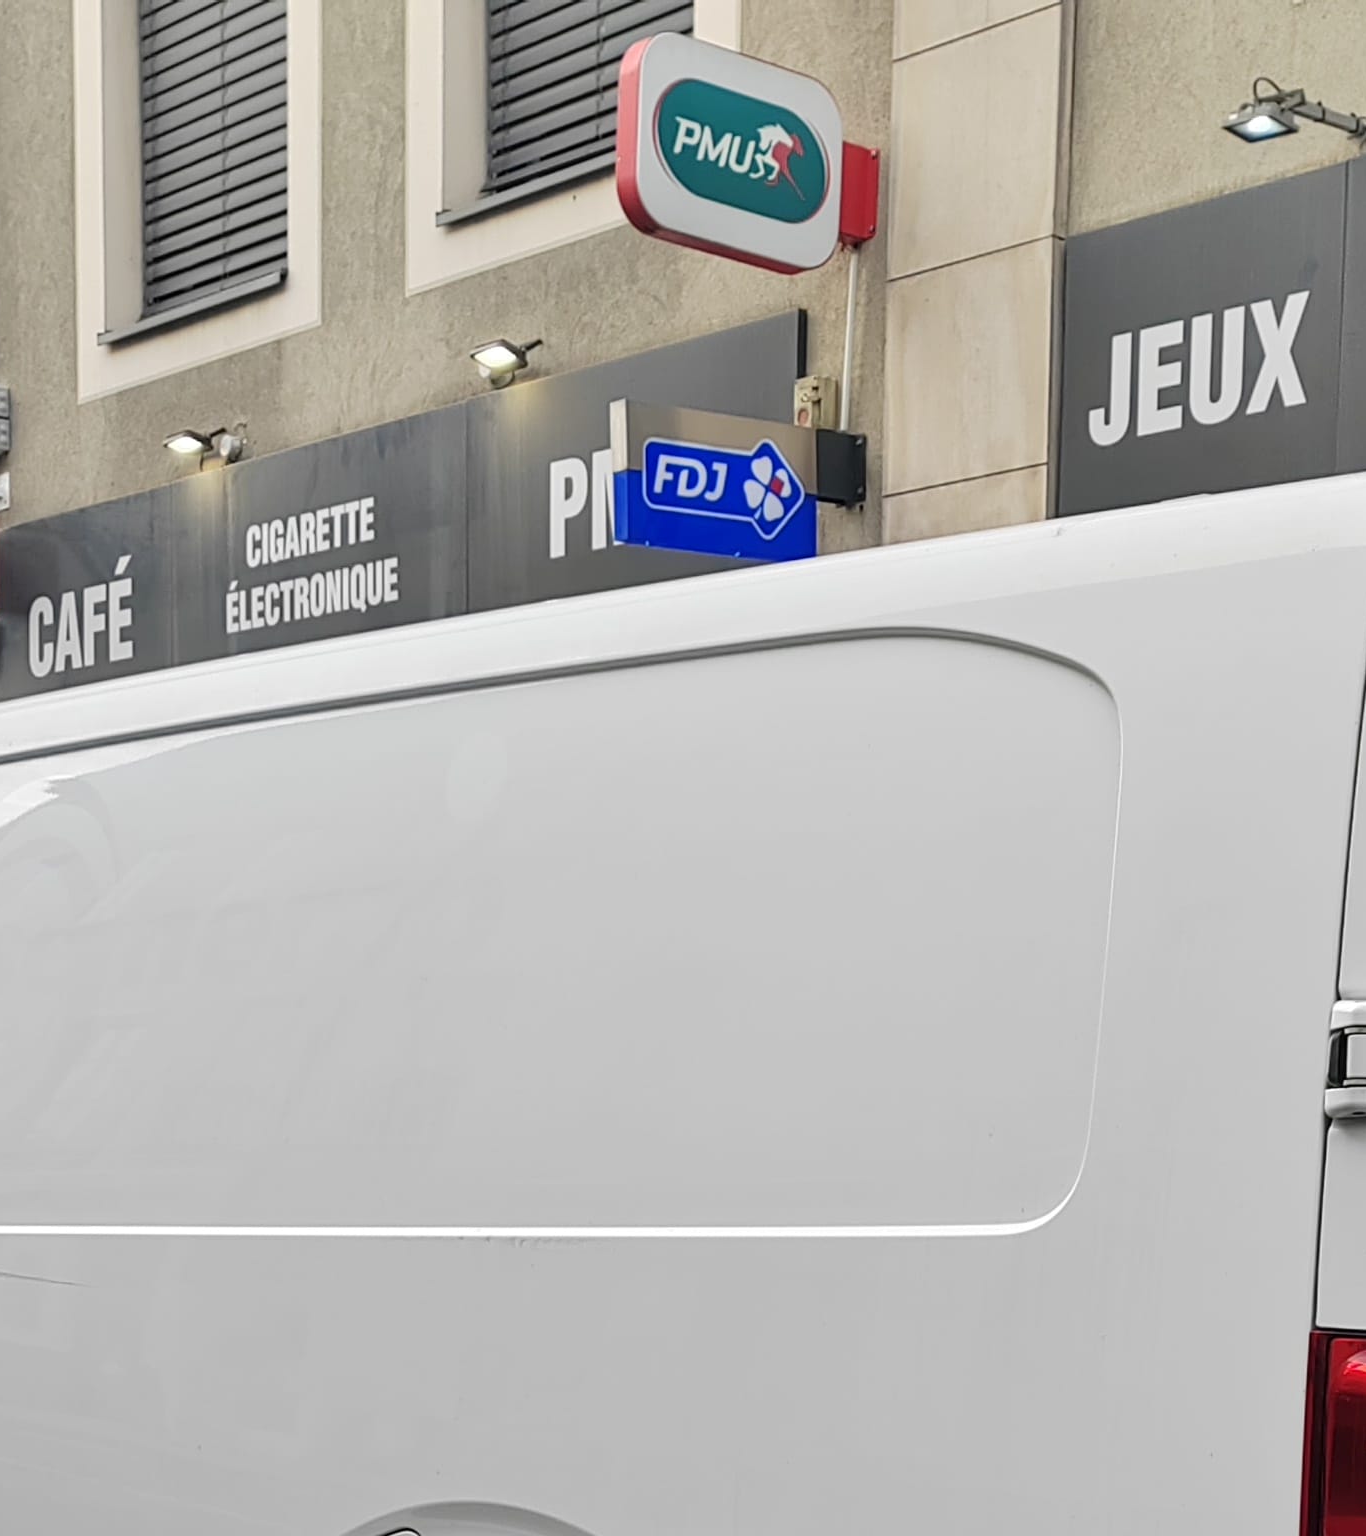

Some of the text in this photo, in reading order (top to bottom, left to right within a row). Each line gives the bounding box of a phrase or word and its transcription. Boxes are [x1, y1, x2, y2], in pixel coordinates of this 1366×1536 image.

[674, 115, 755, 175] PMU
[1088, 290, 1310, 447] JEUX
[653, 454, 727, 502] FDJ
[245, 496, 375, 568] CIGARETTE
[27, 555, 133, 678] CAFÉ
[225, 556, 399, 634] ÉLECTRONIQUE
